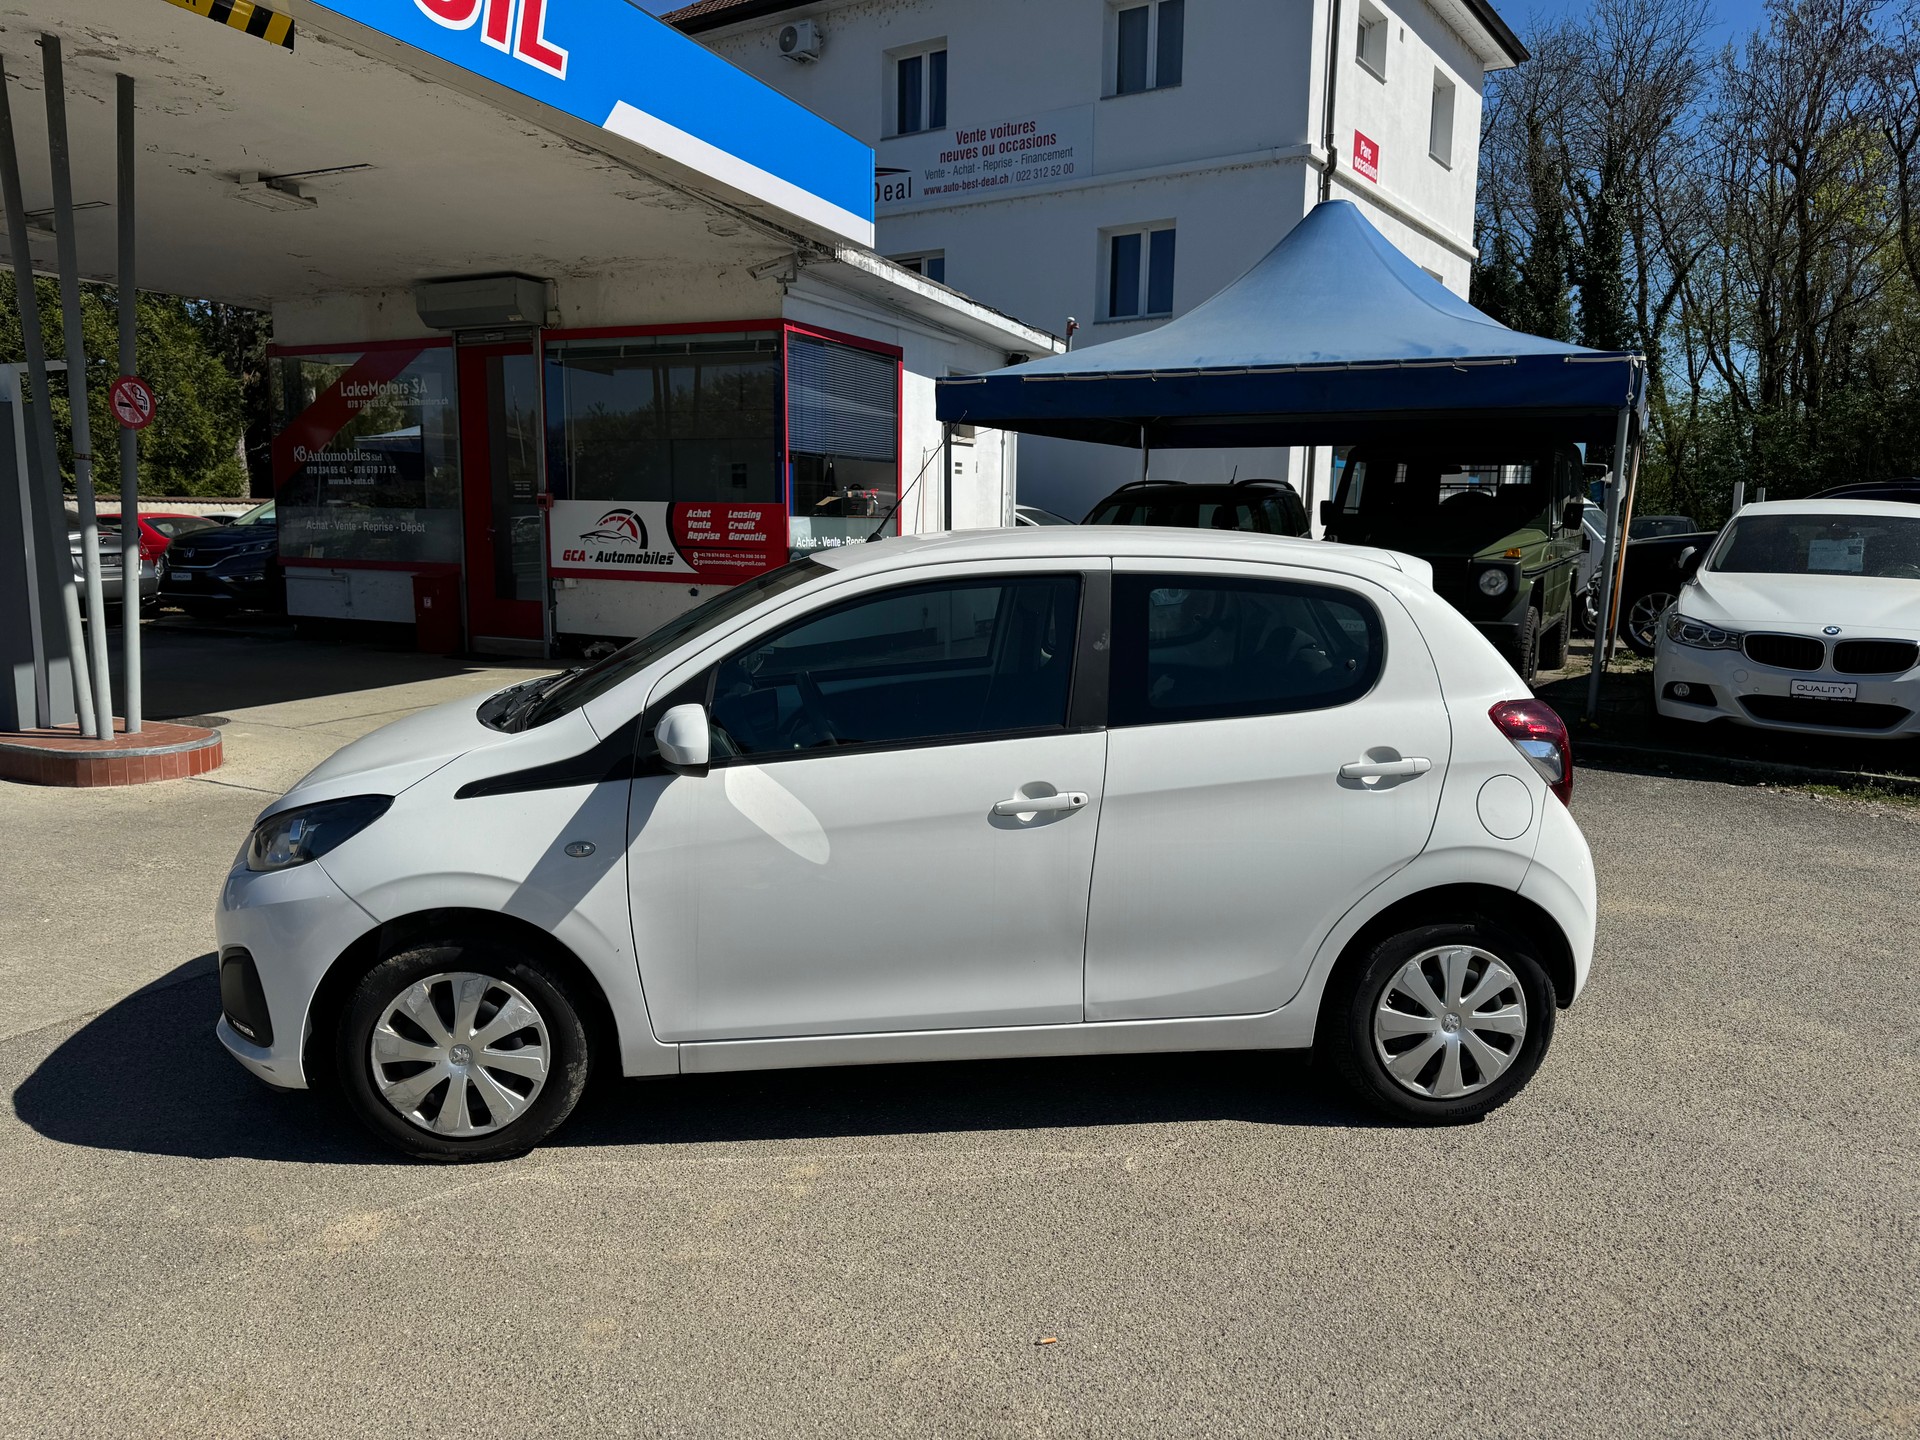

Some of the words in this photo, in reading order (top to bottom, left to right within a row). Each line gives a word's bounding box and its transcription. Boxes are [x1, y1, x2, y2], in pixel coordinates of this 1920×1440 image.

[413, 0, 569, 81] IL
[956, 129, 986, 145] Vente
[990, 121, 1036, 140] voitures
[940, 147, 978, 163] neuves
[982, 144, 995, 157] ou
[999, 133, 1057, 153] occasions
[925, 169, 945, 180] Vente
[953, 163, 975, 176] Achat
[983, 157, 1013, 172] Reprise
[1021, 146, 1073, 165] Financement
[923, 173, 1009, 195] www.auto-best-deal.ch
[1016, 170, 1031, 182] 022
[1033, 166, 1049, 179] 312
[1050, 164, 1061, 177] 52
[1063, 162, 1074, 175] 00
[340, 380, 409, 397] LakeMotors
[411, 378, 428, 394] SA
[347, 400, 358, 409] 079
[306, 466, 317, 474] 079
[339, 466, 347, 474] 41
[354, 466, 365, 474] 076
[379, 466, 387, 474] 77
[389, 466, 396, 474] 12
[686, 509, 711, 518] Achat
[728, 509, 762, 520] Leasing
[306, 520, 328, 530] Achat
[334, 520, 356, 531] Vente
[363, 521, 394, 533] Reprise
[400, 522, 425, 534] Dépôt
[688, 520, 711, 529] Vente
[728, 520, 755, 530] Credit
[687, 531, 720, 541] Reprise
[728, 532, 767, 541] Garantie
[796, 536, 817, 547] Achat
[822, 536, 841, 547] Vente
[846, 535, 867, 546] Repris
[562, 550, 586, 562] GCA
[594, 551, 674, 565] Automobiles
[1796, 684, 1845, 693] QUALITY
